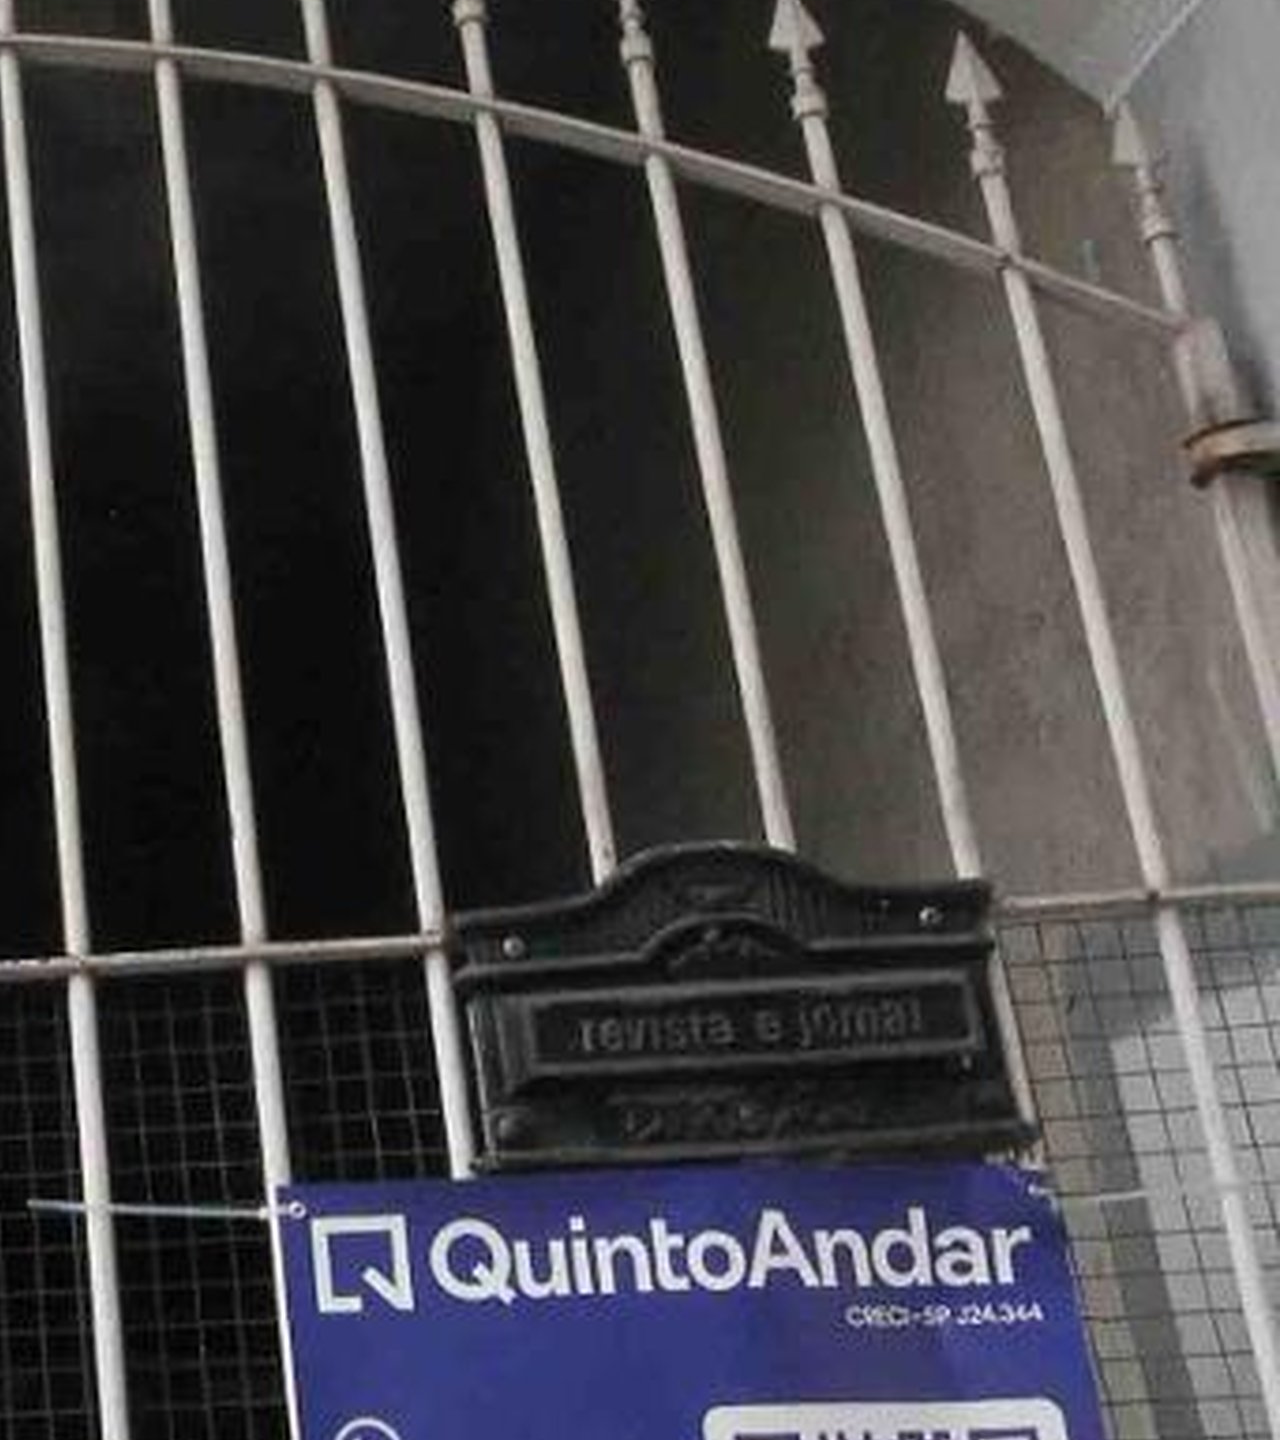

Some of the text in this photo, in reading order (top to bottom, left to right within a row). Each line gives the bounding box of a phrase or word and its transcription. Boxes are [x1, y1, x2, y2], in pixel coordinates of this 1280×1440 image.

[578, 1006, 737, 1054] revista
[753, 1013, 783, 1046] e
[428, 1206, 1033, 1306] QuintoAndar
